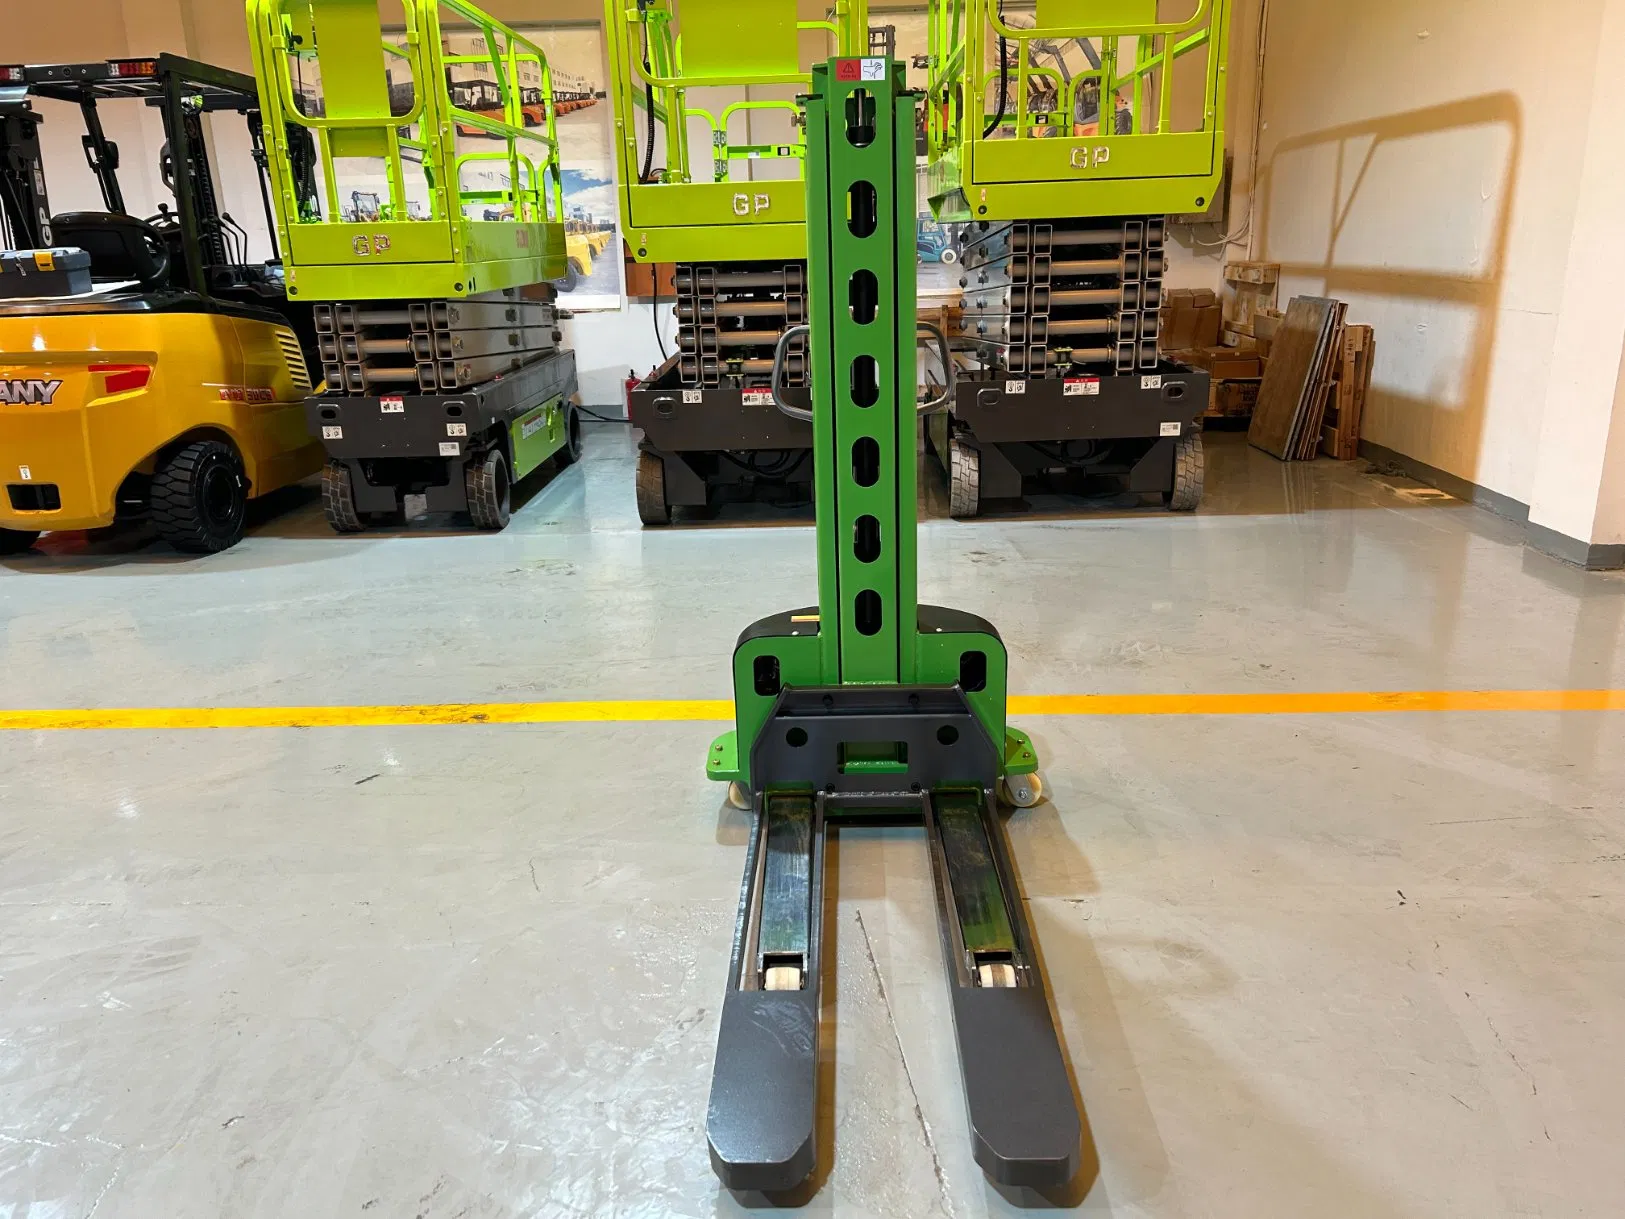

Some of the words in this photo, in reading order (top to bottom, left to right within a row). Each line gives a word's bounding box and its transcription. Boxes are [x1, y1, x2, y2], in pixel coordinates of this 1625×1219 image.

[1070, 146, 1110, 169] GP
[733, 193, 770, 216] GP
[39, 206, 53, 247] GP
[352, 234, 391, 256] GP
